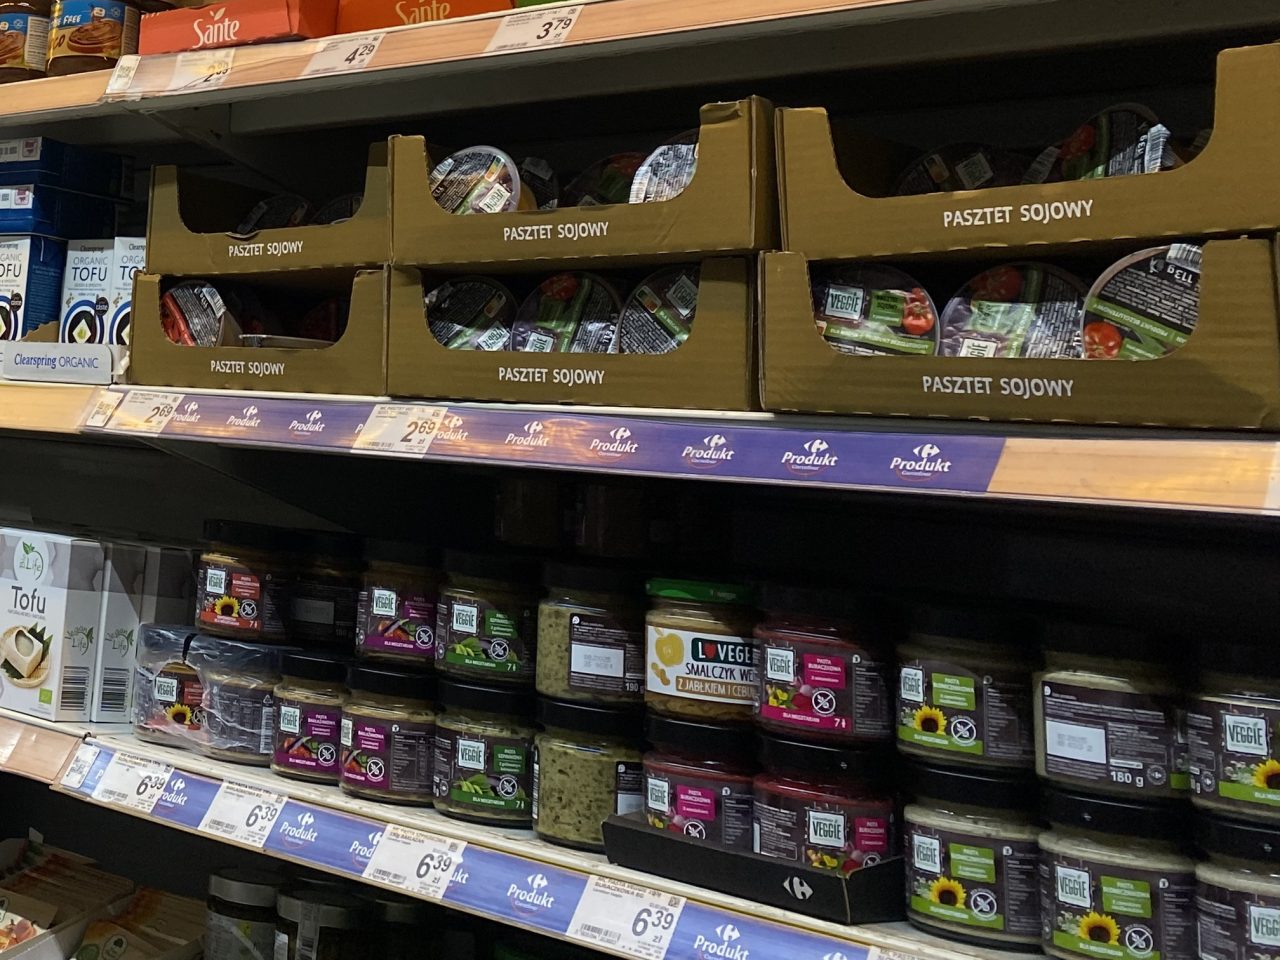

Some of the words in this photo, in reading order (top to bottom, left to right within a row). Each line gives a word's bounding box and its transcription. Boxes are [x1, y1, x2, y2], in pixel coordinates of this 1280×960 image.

[192, 17, 240, 49] Sante
[943, 206, 1013, 228] PASZTET
[1019, 199, 1094, 225] SOJOWY
[503, 224, 553, 242] PASZTET
[557, 221, 609, 241] SOJOWY
[228, 243, 264, 258] PASZTET
[267, 240, 304, 258] SOJOWY
[73, 256, 108, 266] ORGANIC
[71, 267, 107, 282] TOFU
[830, 290, 861, 313] VEGGIE
[14, 353, 57, 369] Clearspring
[59, 356, 99, 369] ORGANIC
[210, 359, 247, 375] PASZTET
[248, 361, 285, 378] SOJOWY
[498, 366, 549, 385] PASZTET
[552, 369, 605, 388] SOJOWY
[922, 375, 993, 395] PASZTET
[999, 377, 1074, 401] SOJOWY
[227, 415, 261, 428] Produkt
[289, 420, 325, 434] Produkt
[505, 431, 549, 448] Produkt
[589, 437, 638, 455] Produkt
[682, 445, 735, 462] Produkt
[781, 450, 838, 469] Produkt
[889, 455, 952, 476] Produkt
[11, 585, 46, 614] Tofu
[375, 596, 394, 611] VEGGIE
[455, 611, 475, 628] VEGGIE
[686, 662, 738, 678] SMALCZYK
[769, 654, 791, 675] VEGGIE
[685, 680, 726, 697] JABŁKIEM
[1228, 725, 1264, 746] VEGGIE
[460, 747, 483, 764] VEGGIE
[160, 790, 188, 805] rodukt
[280, 823, 318, 842] Produkt
[811, 821, 842, 840] VEGGIE
[350, 842, 374, 858] Prod
[914, 846, 939, 864] VEGGIE
[507, 884, 555, 908] Produkt
[1059, 877, 1087, 899] VEGGIE
[693, 935, 749, 960] Produkt
